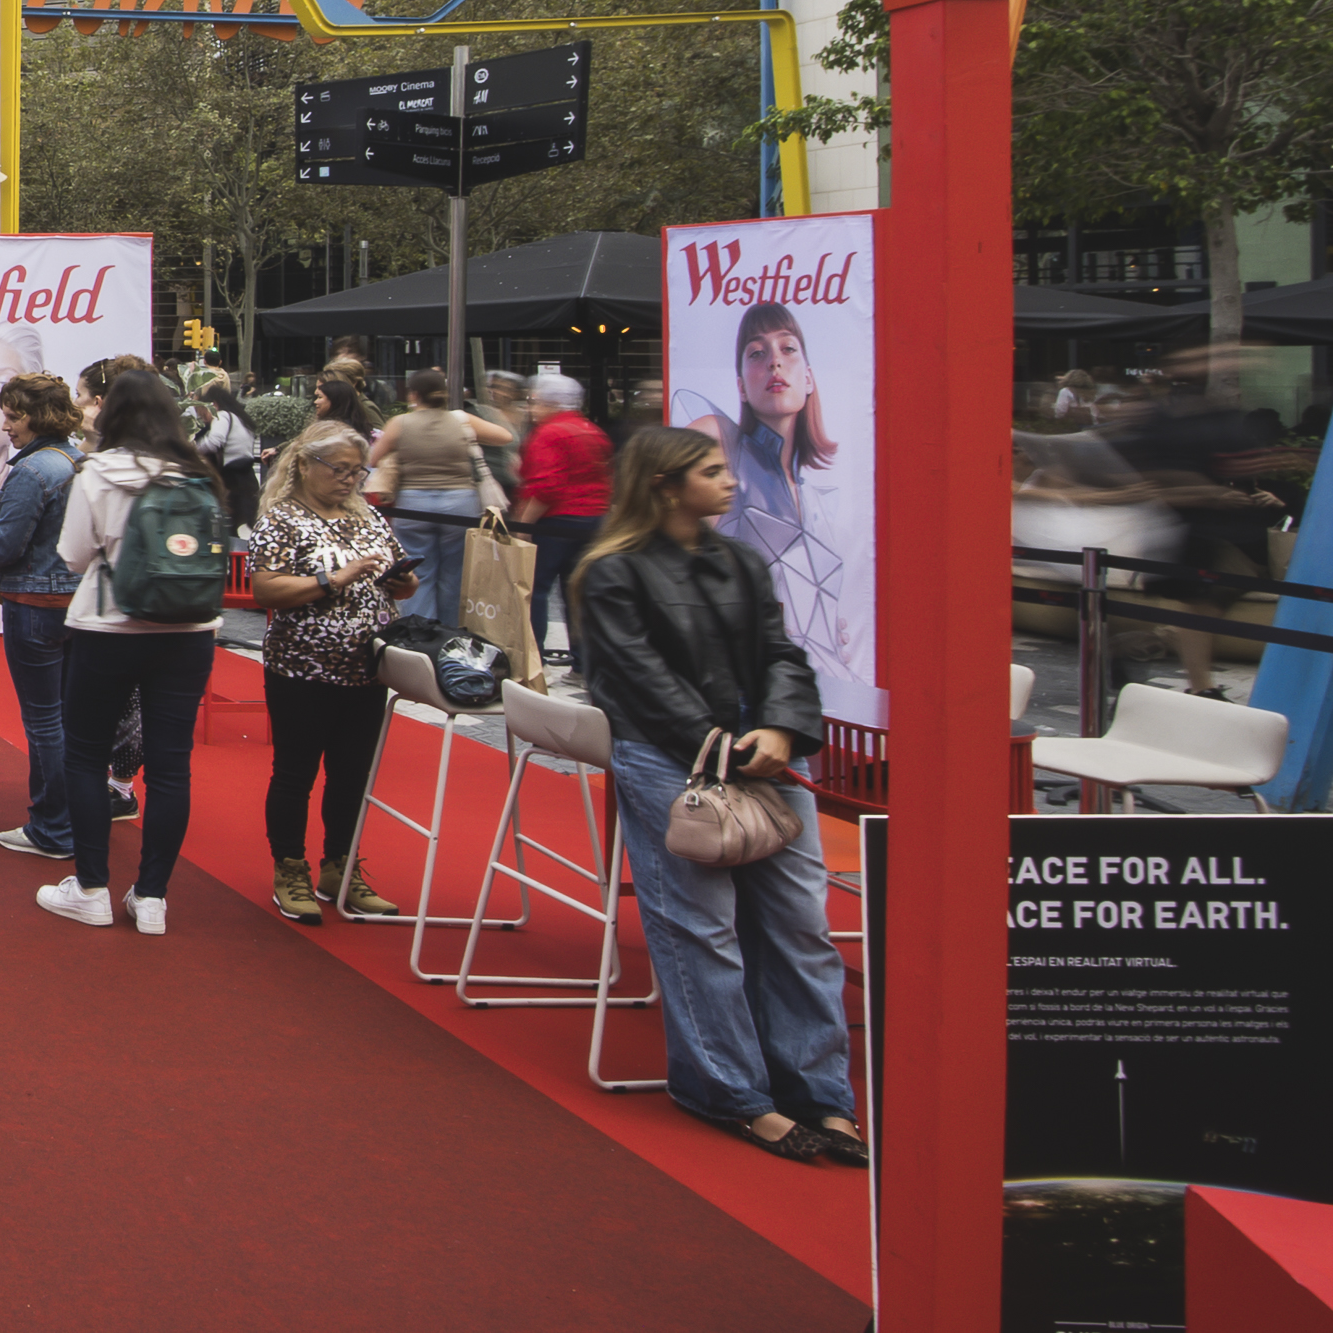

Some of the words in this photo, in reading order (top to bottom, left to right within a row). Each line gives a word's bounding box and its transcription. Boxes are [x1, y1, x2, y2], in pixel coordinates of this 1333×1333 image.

[401, 80, 435, 92] Cinema
[679, 238, 858, 306] Westfield
[1007, 856, 1089, 885] ACE
[1099, 856, 1170, 885] FOR
[1180, 856, 1266, 885] ALL.
[1073, 900, 1144, 929] FOR
[1155, 901, 1289, 929] EARTH.
[1048, 957, 1064, 967] EN
[1067, 957, 1123, 967] REALITAT
[1125, 957, 1178, 968] VIRTUAL.
